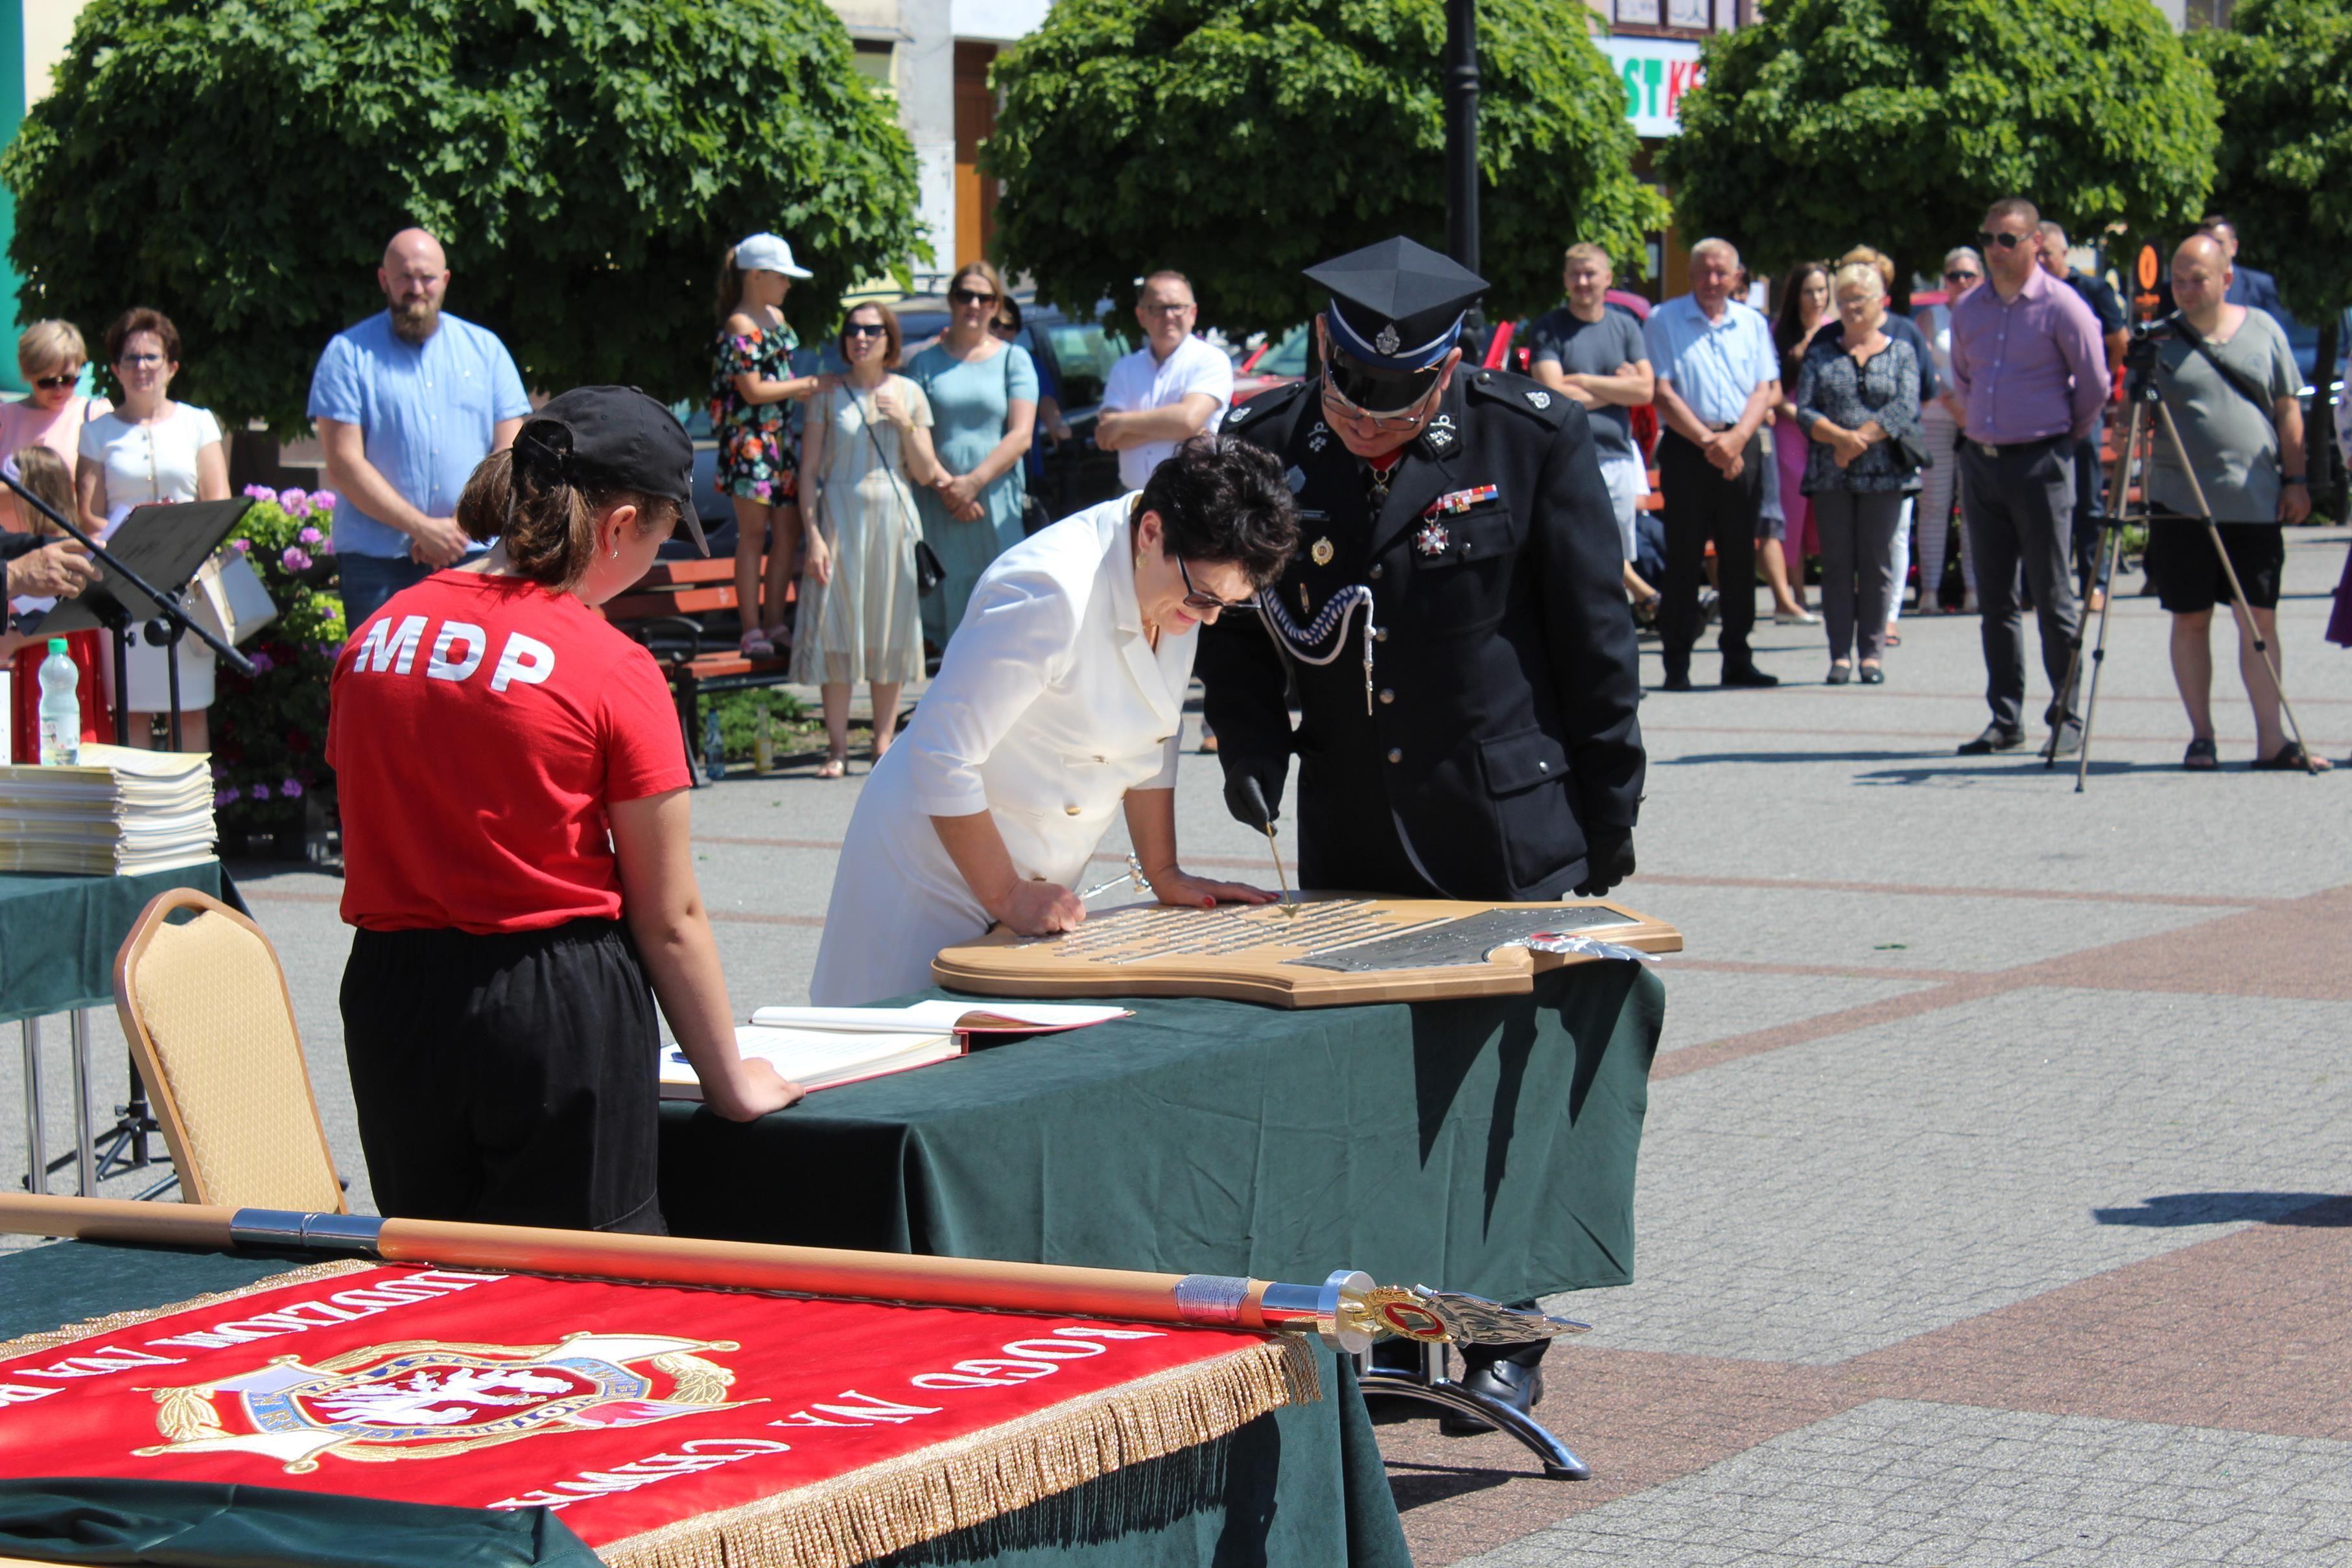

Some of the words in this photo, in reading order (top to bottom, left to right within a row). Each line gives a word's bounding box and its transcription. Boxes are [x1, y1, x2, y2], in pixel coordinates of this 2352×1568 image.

[1608, 56, 1662, 117] ST
[353, 615, 555, 692] MDP
[145, 1269, 510, 1348] LUDZIOM
[13, 1345, 188, 1377] NA
[768, 1390, 943, 1427] NA
[486, 1438, 790, 1512] CHWA
